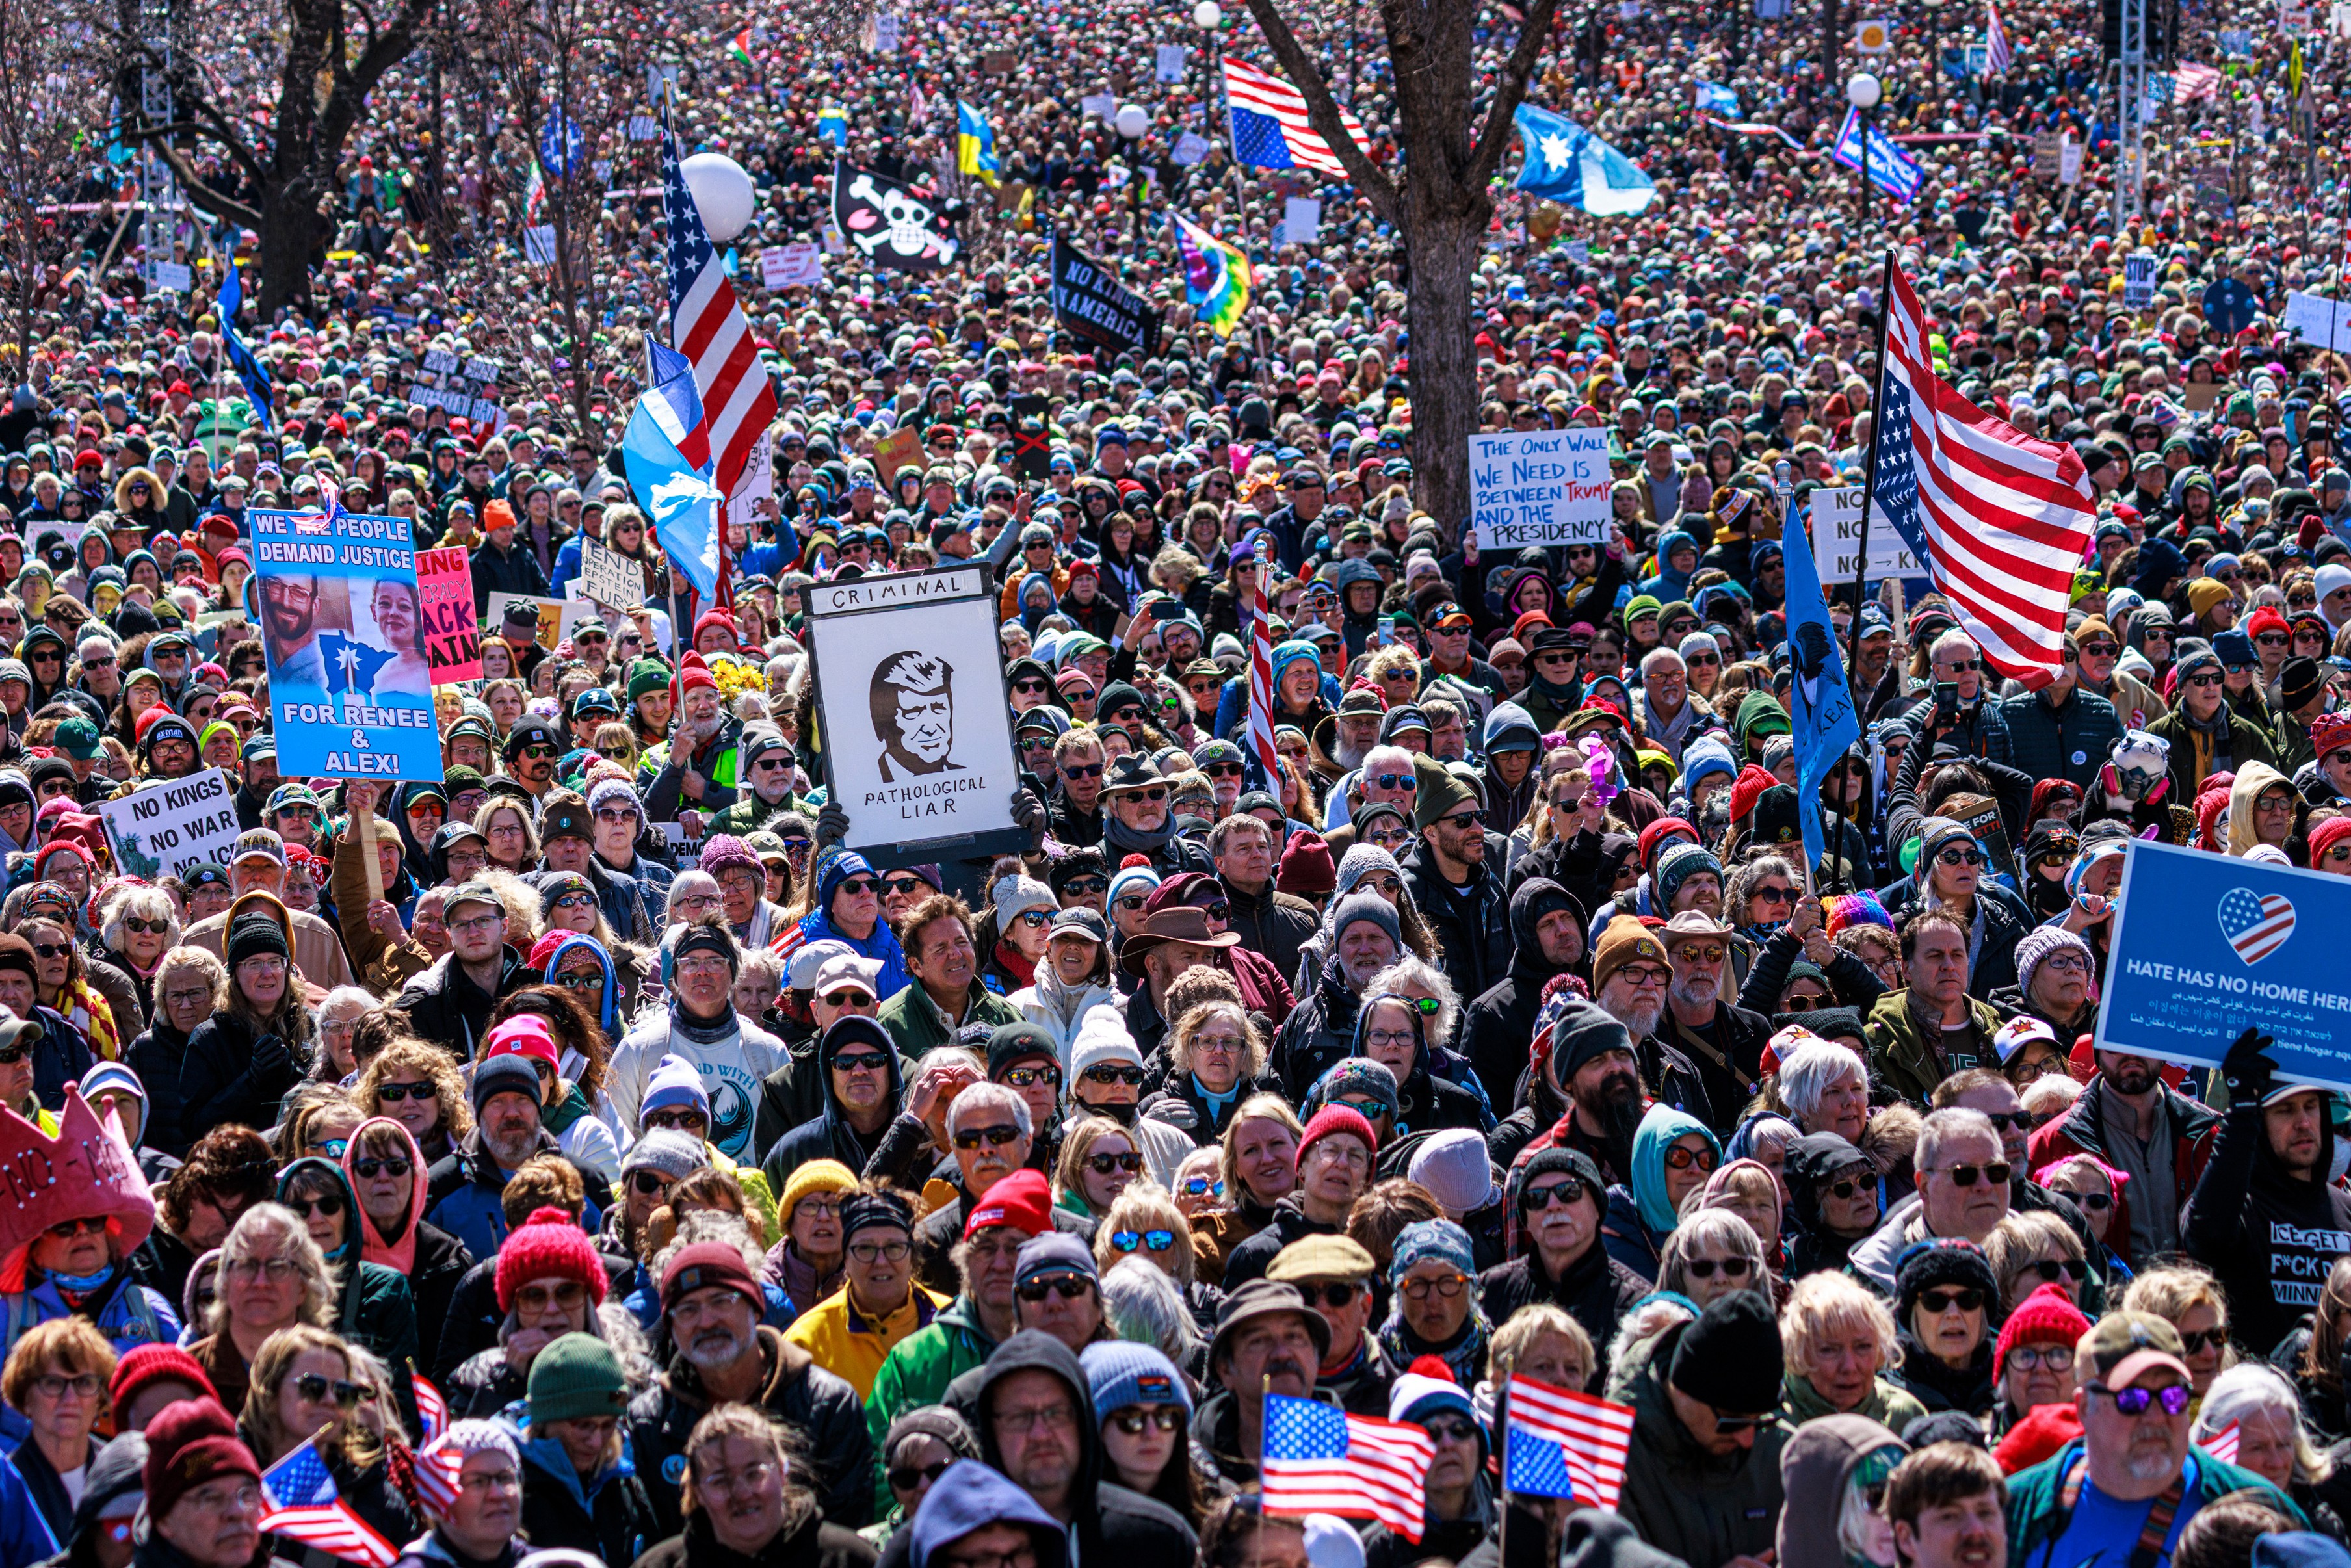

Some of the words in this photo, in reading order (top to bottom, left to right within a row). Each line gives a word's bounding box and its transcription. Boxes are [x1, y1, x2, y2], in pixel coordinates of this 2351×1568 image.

[1064, 260, 1094, 287] NO
[2127, 257, 2155, 281] STOP
[1067, 292, 1145, 347] AMERICA
[425, 351, 459, 374] SAME
[1477, 440, 1514, 458] THE
[1521, 438, 1562, 455] ONLY
[1566, 434, 1607, 452] WALL
[1474, 464, 1503, 489] WE
[1512, 458, 1566, 486] NEED
[1573, 460, 1590, 478] IS
[1476, 486, 1562, 507] BETWEEN
[1564, 480, 1611, 503] TRUMP
[1835, 490, 1865, 510] NO
[254, 514, 289, 535] WE
[335, 518, 410, 542] PEOPLE
[1475, 507, 1514, 529] AND
[1518, 504, 1555, 524] THE
[1490, 518, 1606, 547] PRESIDENCY
[259, 542, 335, 564] DEMAND
[339, 545, 413, 570] JUSTICE
[416, 549, 464, 576] ING
[590, 543, 639, 577] END
[1837, 555, 1869, 574] NO
[582, 556, 641, 591] OPERATION
[584, 567, 634, 599] EPSTEIN
[832, 577, 960, 609] CRIMINAL
[425, 633, 481, 670] AIN
[283, 703, 338, 725] FOR
[343, 705, 430, 729] RENEE
[350, 728, 371, 750] &
[325, 751, 400, 775] ALEX!
[131, 798, 161, 822] NO
[164, 777, 224, 811] KINGS
[865, 776, 987, 806] PATHOLOGICAL
[902, 798, 956, 819] LIAR
[1972, 811, 1996, 828] FOR
[150, 829, 179, 854] NO
[183, 810, 235, 841] WAR
[243, 835, 276, 848] NAVY
[843, 858, 861, 868] loppet
[2127, 958, 2174, 982] HATE
[2177, 967, 2214, 989] HAS
[2218, 974, 2248, 995] NO
[2252, 980, 2309, 1006] HOME
[2226, 1029, 2236, 1040] El
[2277, 1039, 2302, 1052] tiene
[2304, 1042, 2334, 1058] hogar
[716, 1064, 757, 1091] WITH
[2273, 1224, 2303, 1243] ICE
[2304, 1231, 2339, 1249] GET
[2273, 1283, 2322, 1303] MINN
